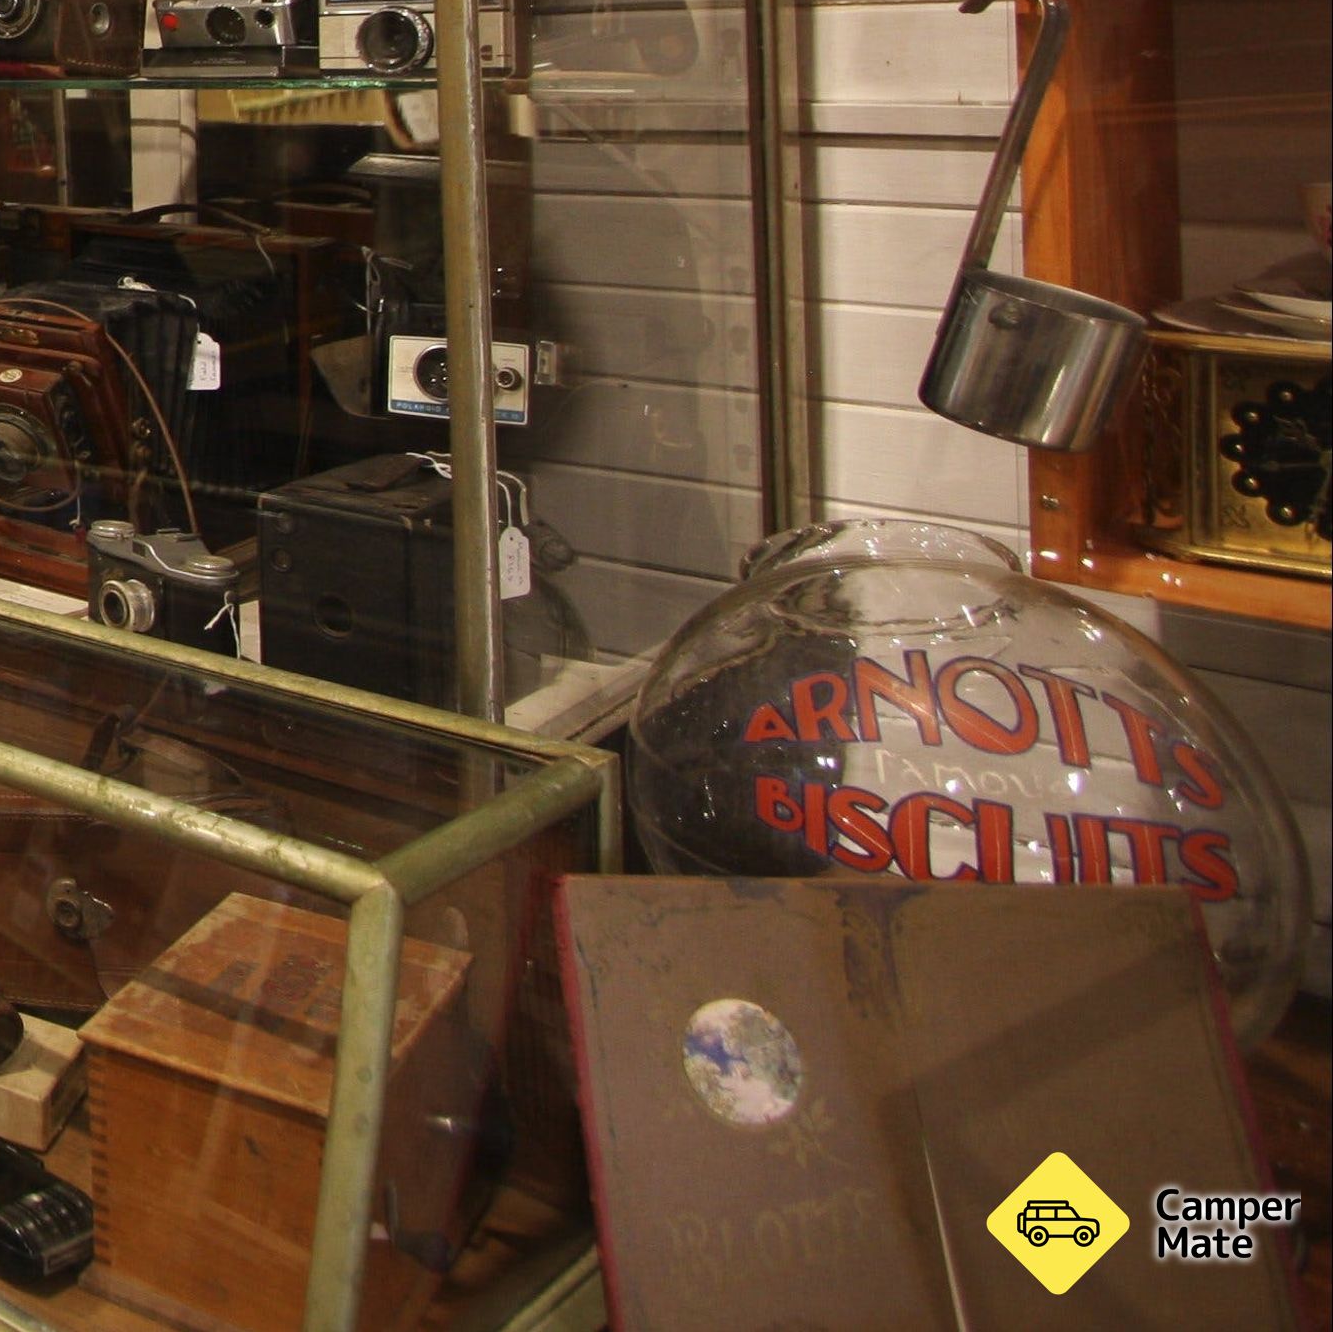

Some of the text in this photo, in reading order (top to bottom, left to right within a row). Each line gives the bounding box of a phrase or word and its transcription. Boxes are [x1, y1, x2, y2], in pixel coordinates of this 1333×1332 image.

[395, 401, 442, 413] POLAROID
[741, 648, 1232, 811] ARNOTTS
[752, 774, 1238, 904] BISCUITS
